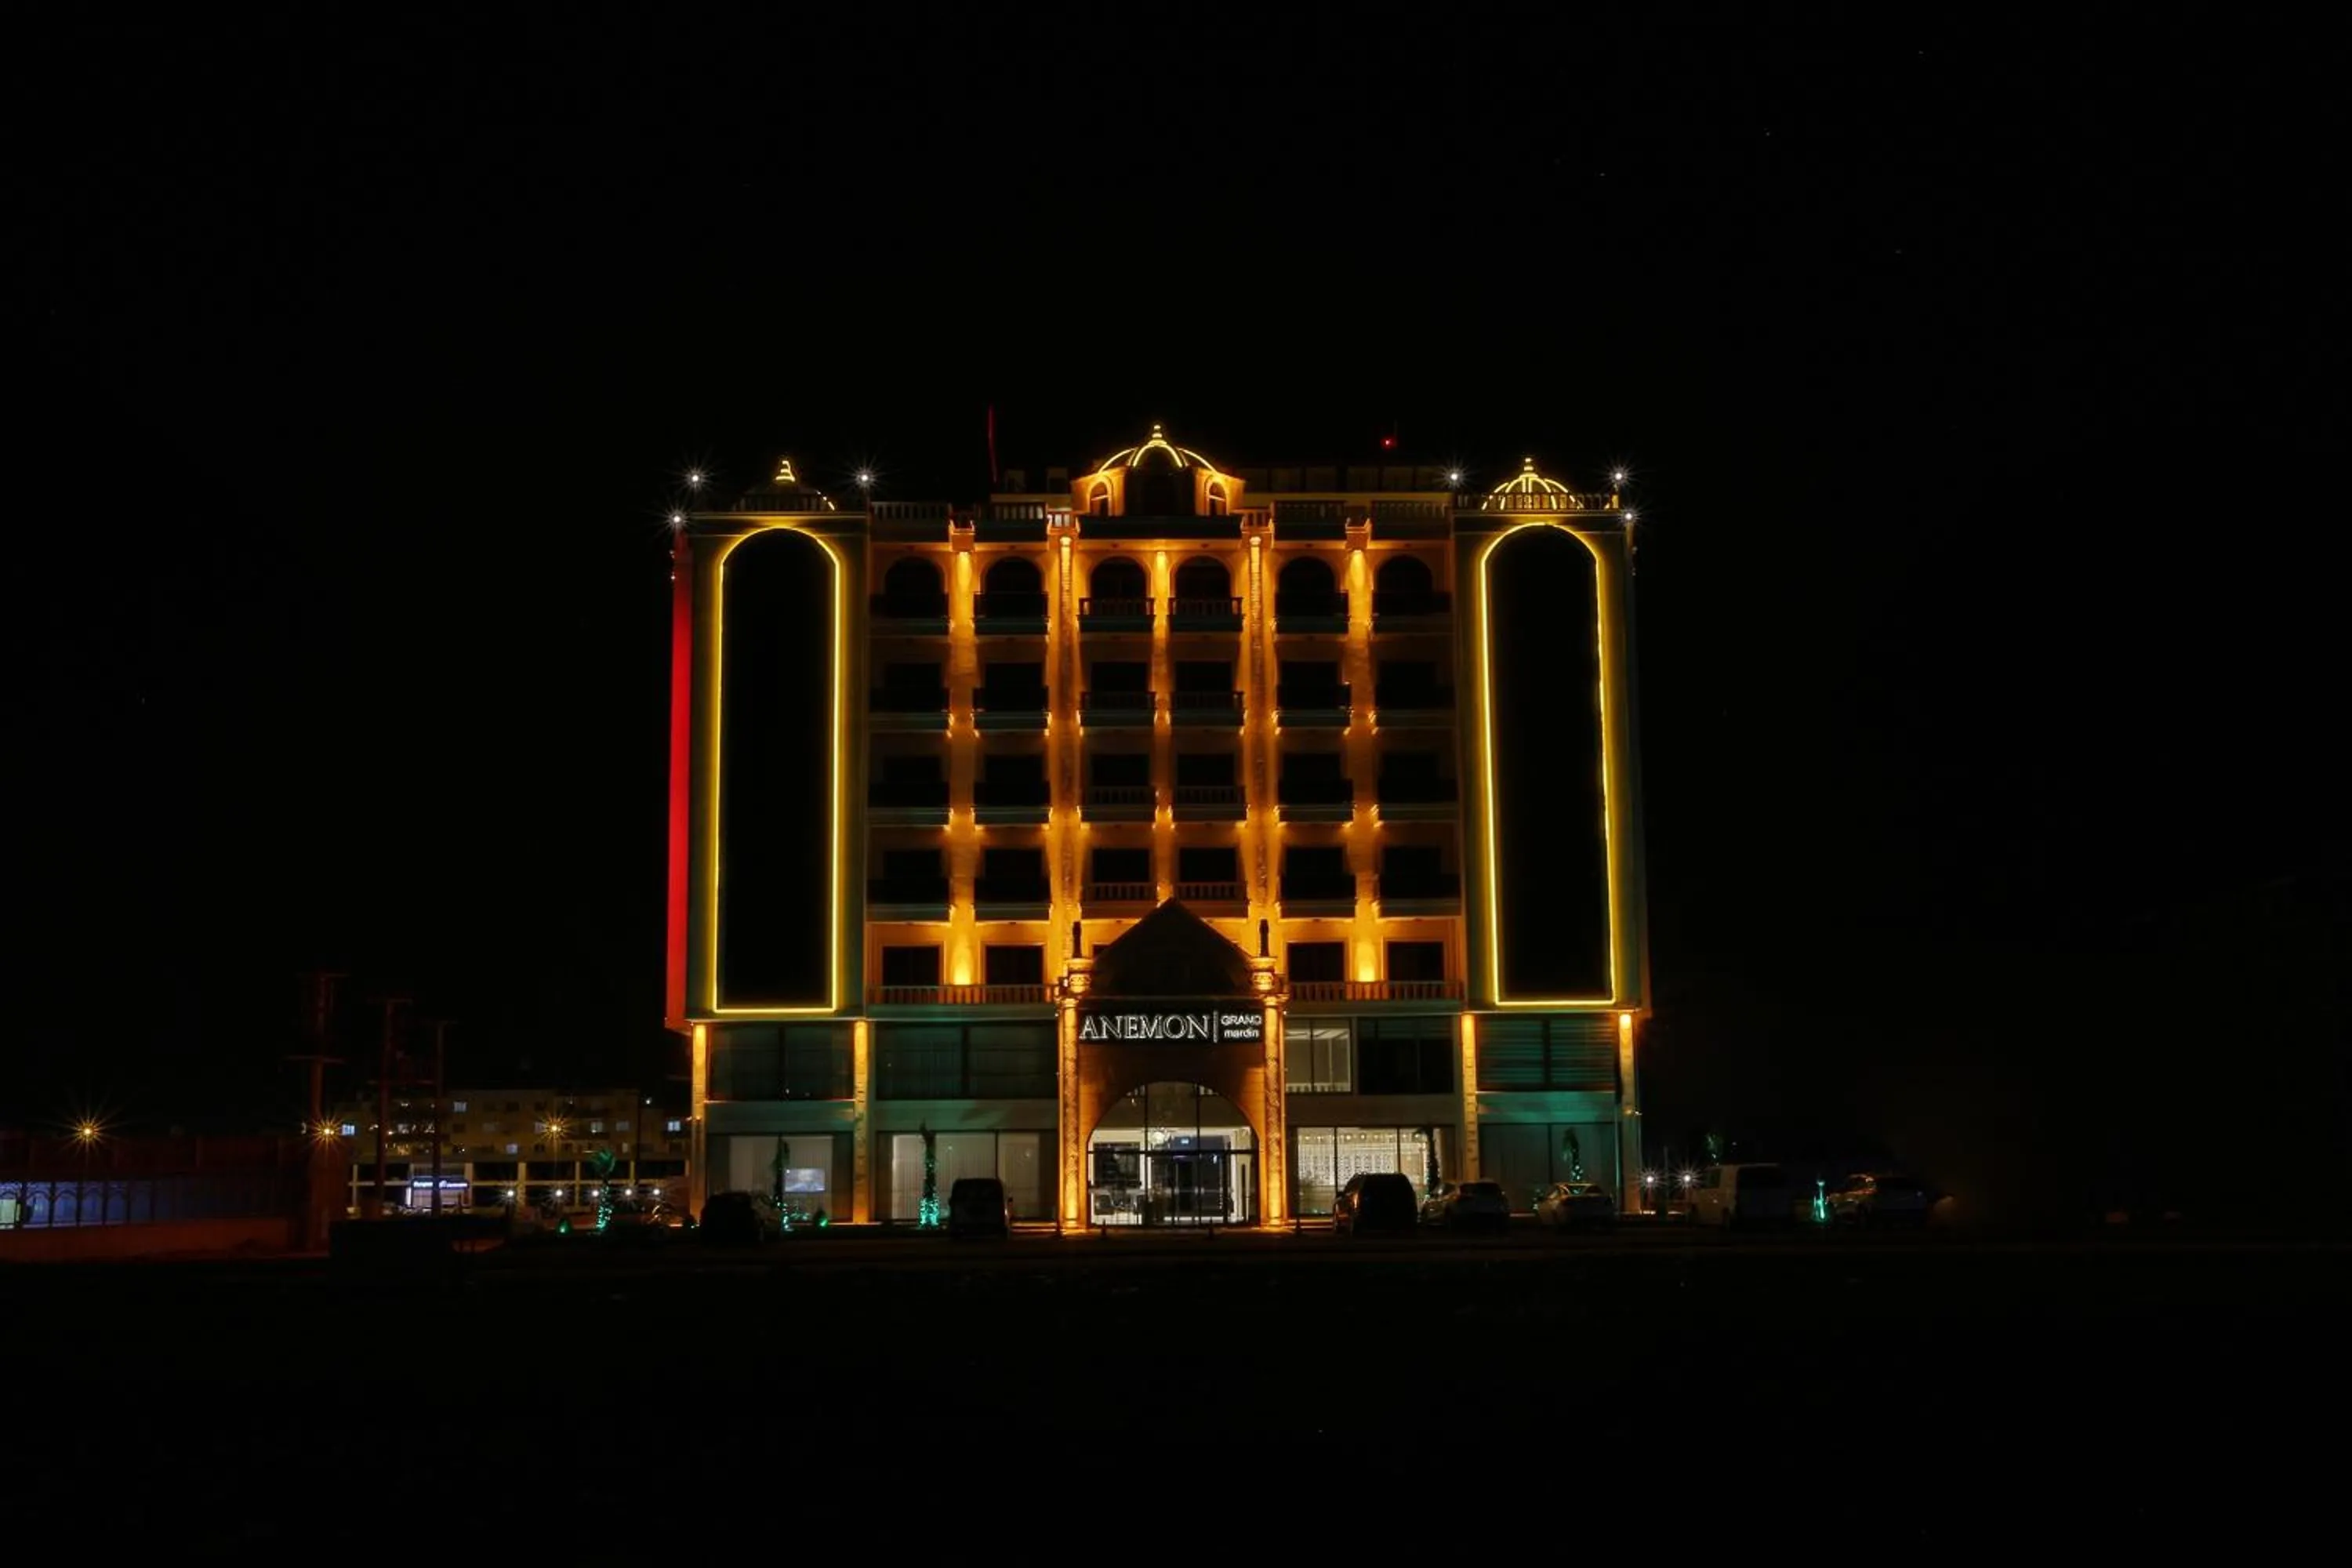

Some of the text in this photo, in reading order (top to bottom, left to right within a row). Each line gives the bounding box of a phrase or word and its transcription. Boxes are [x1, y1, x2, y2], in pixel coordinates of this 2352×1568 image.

[1221, 1014, 1261, 1025] GRAND
[1079, 1014, 1209, 1040] ANEMON
[1224, 1028, 1259, 1039] mardin
